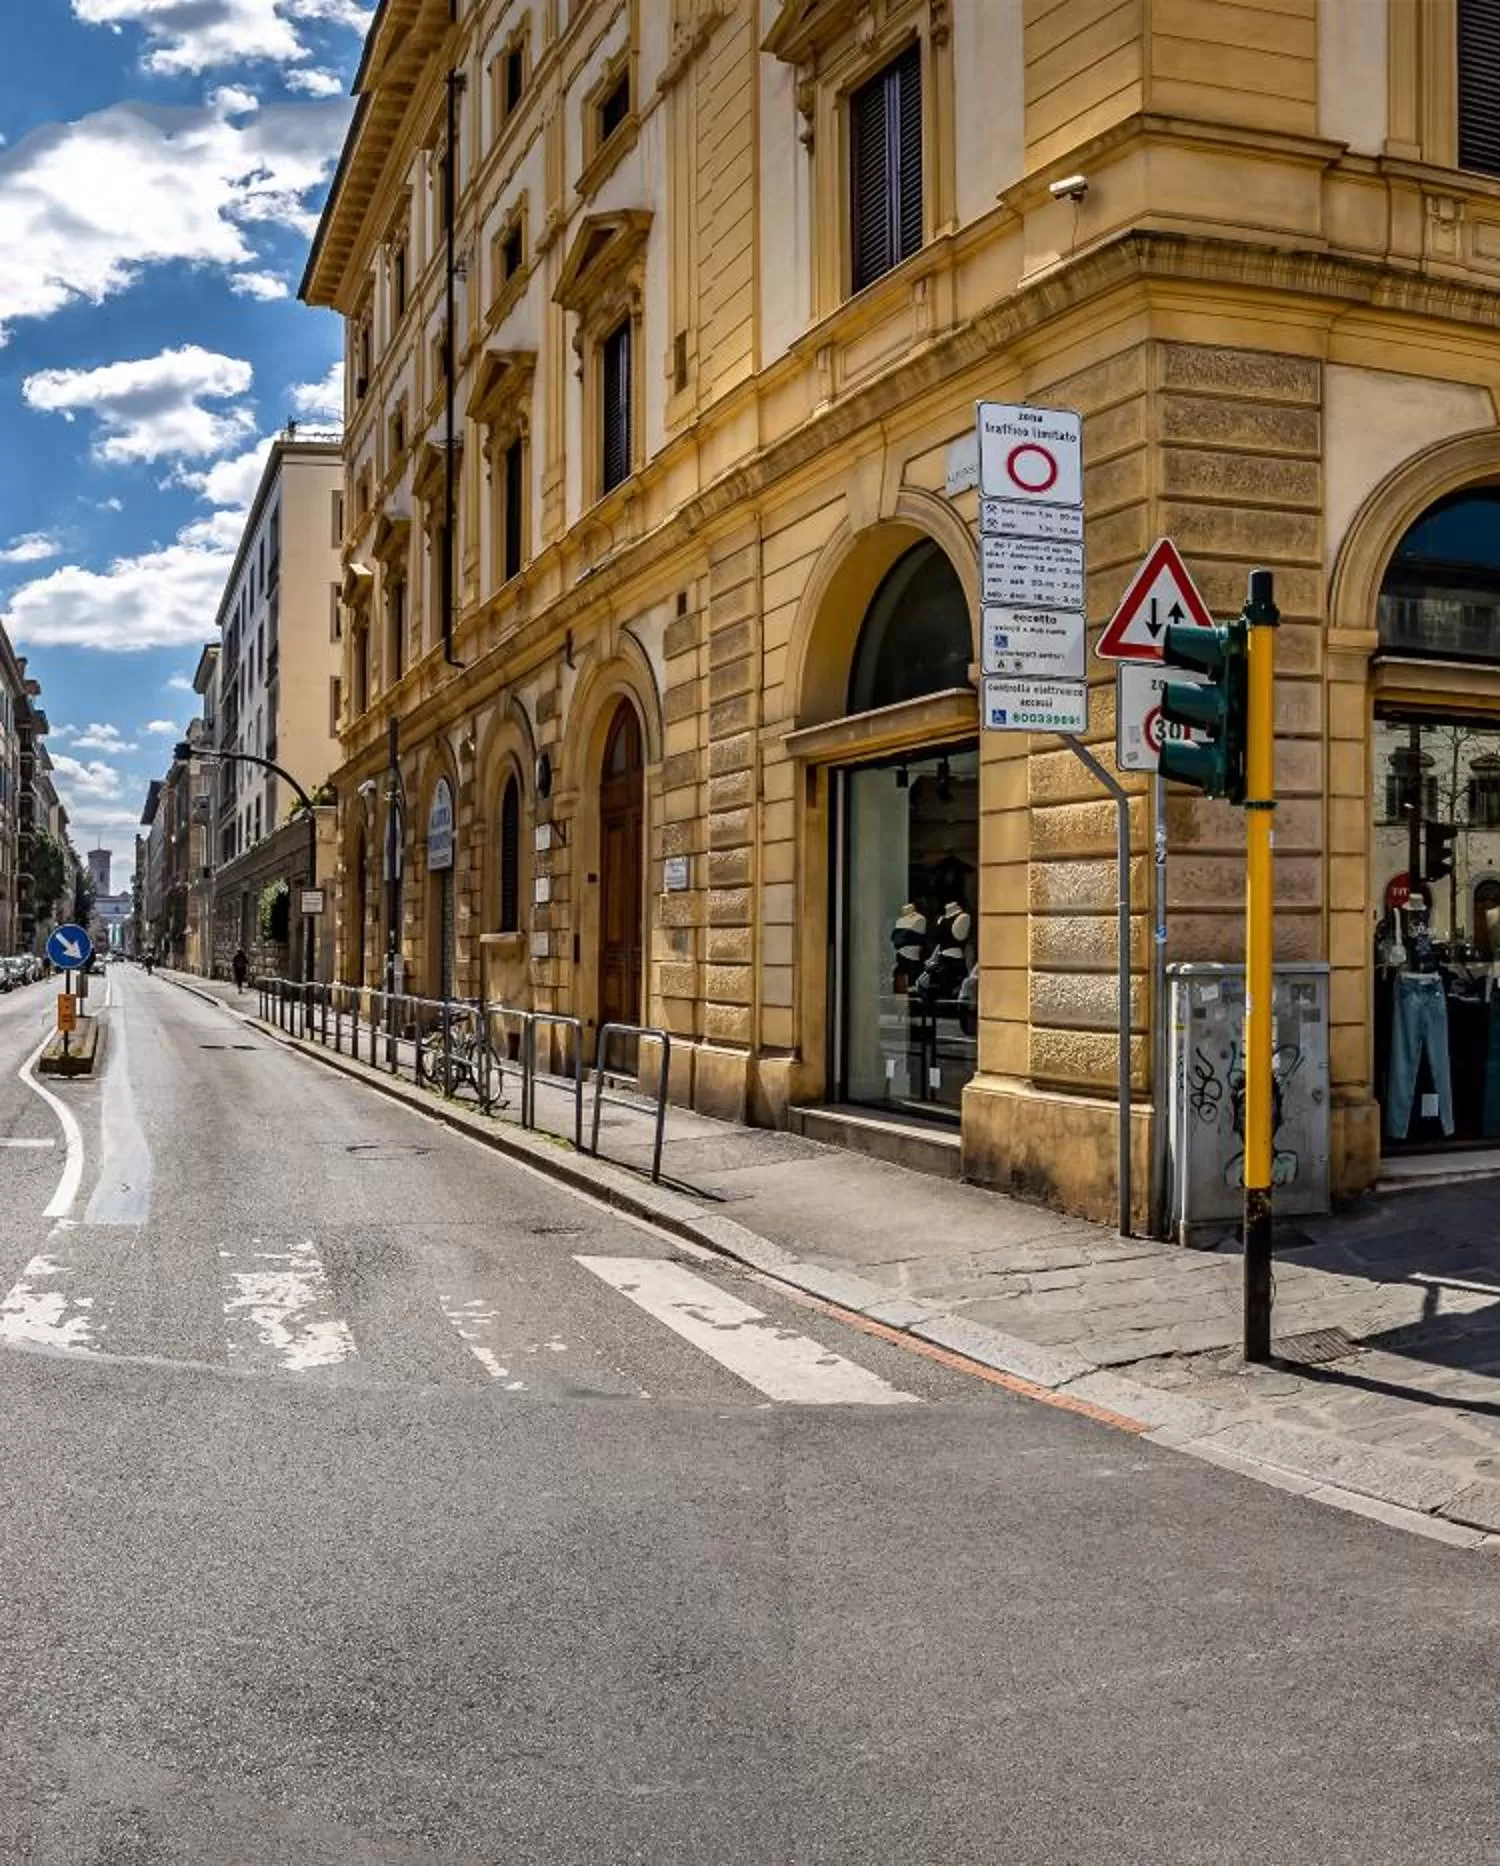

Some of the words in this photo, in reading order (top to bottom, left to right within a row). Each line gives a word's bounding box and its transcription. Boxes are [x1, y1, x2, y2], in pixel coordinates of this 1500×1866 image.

[985, 422, 1029, 437] traffico
[1032, 427, 1077, 442] limitato
[1013, 613, 1057, 625] eccetto
[1154, 719, 1181, 741] 30
